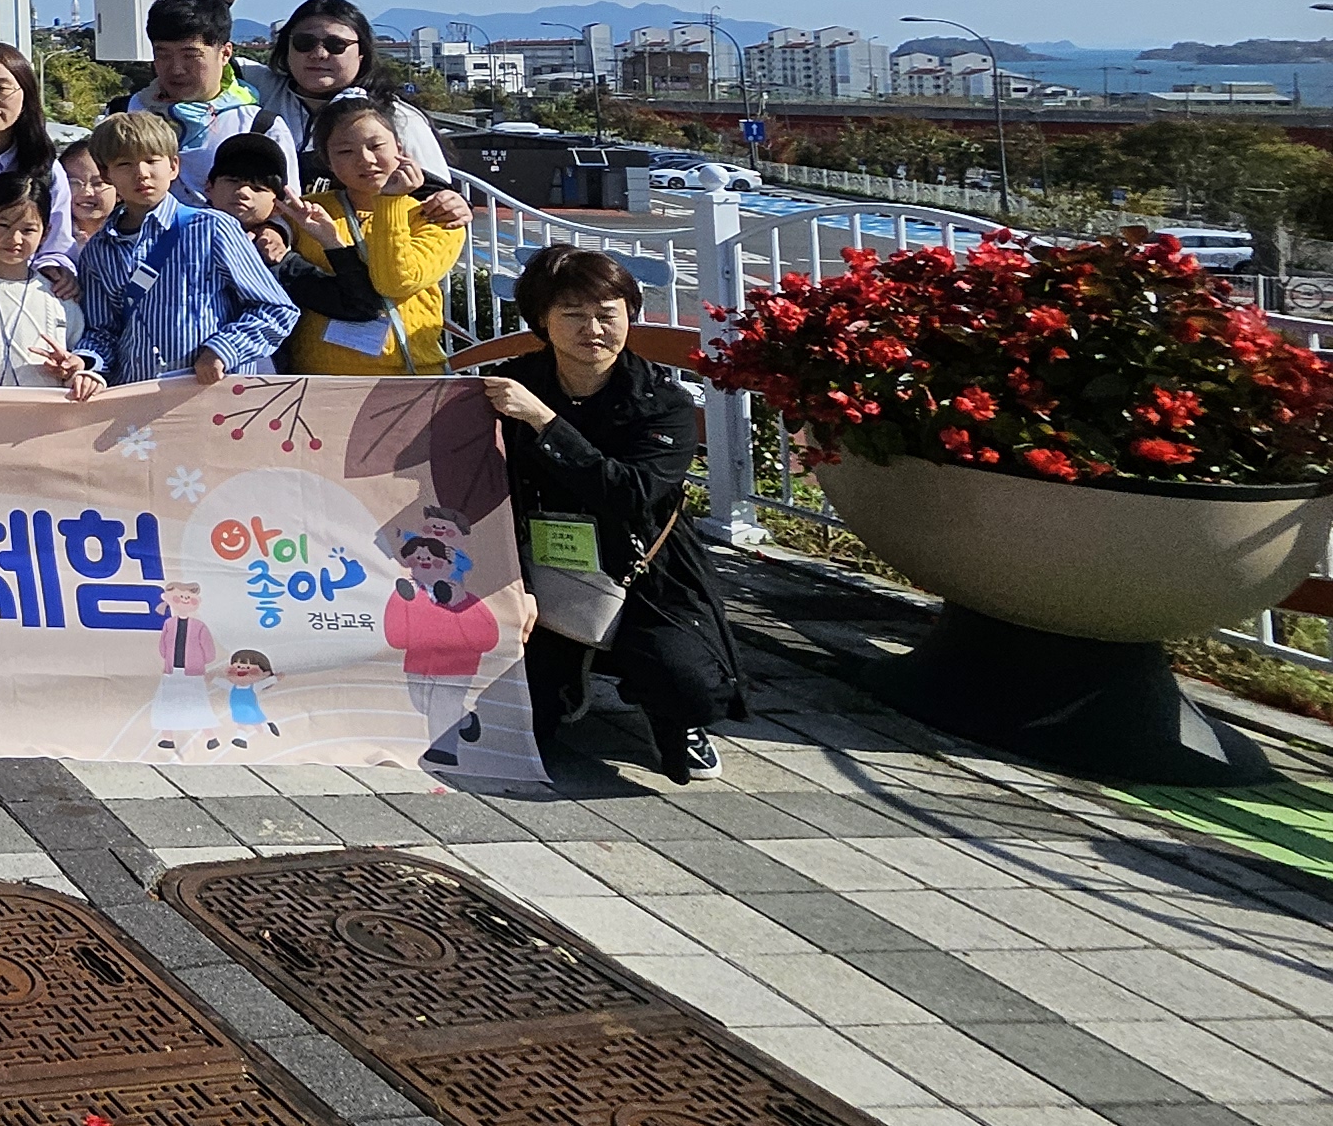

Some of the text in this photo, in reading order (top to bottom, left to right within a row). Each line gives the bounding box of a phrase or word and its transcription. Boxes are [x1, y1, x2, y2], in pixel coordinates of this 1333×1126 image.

[210, 515, 309, 564] 아이
[246, 559, 368, 629] 좋아
[307, 612, 376, 632] 경남교육
